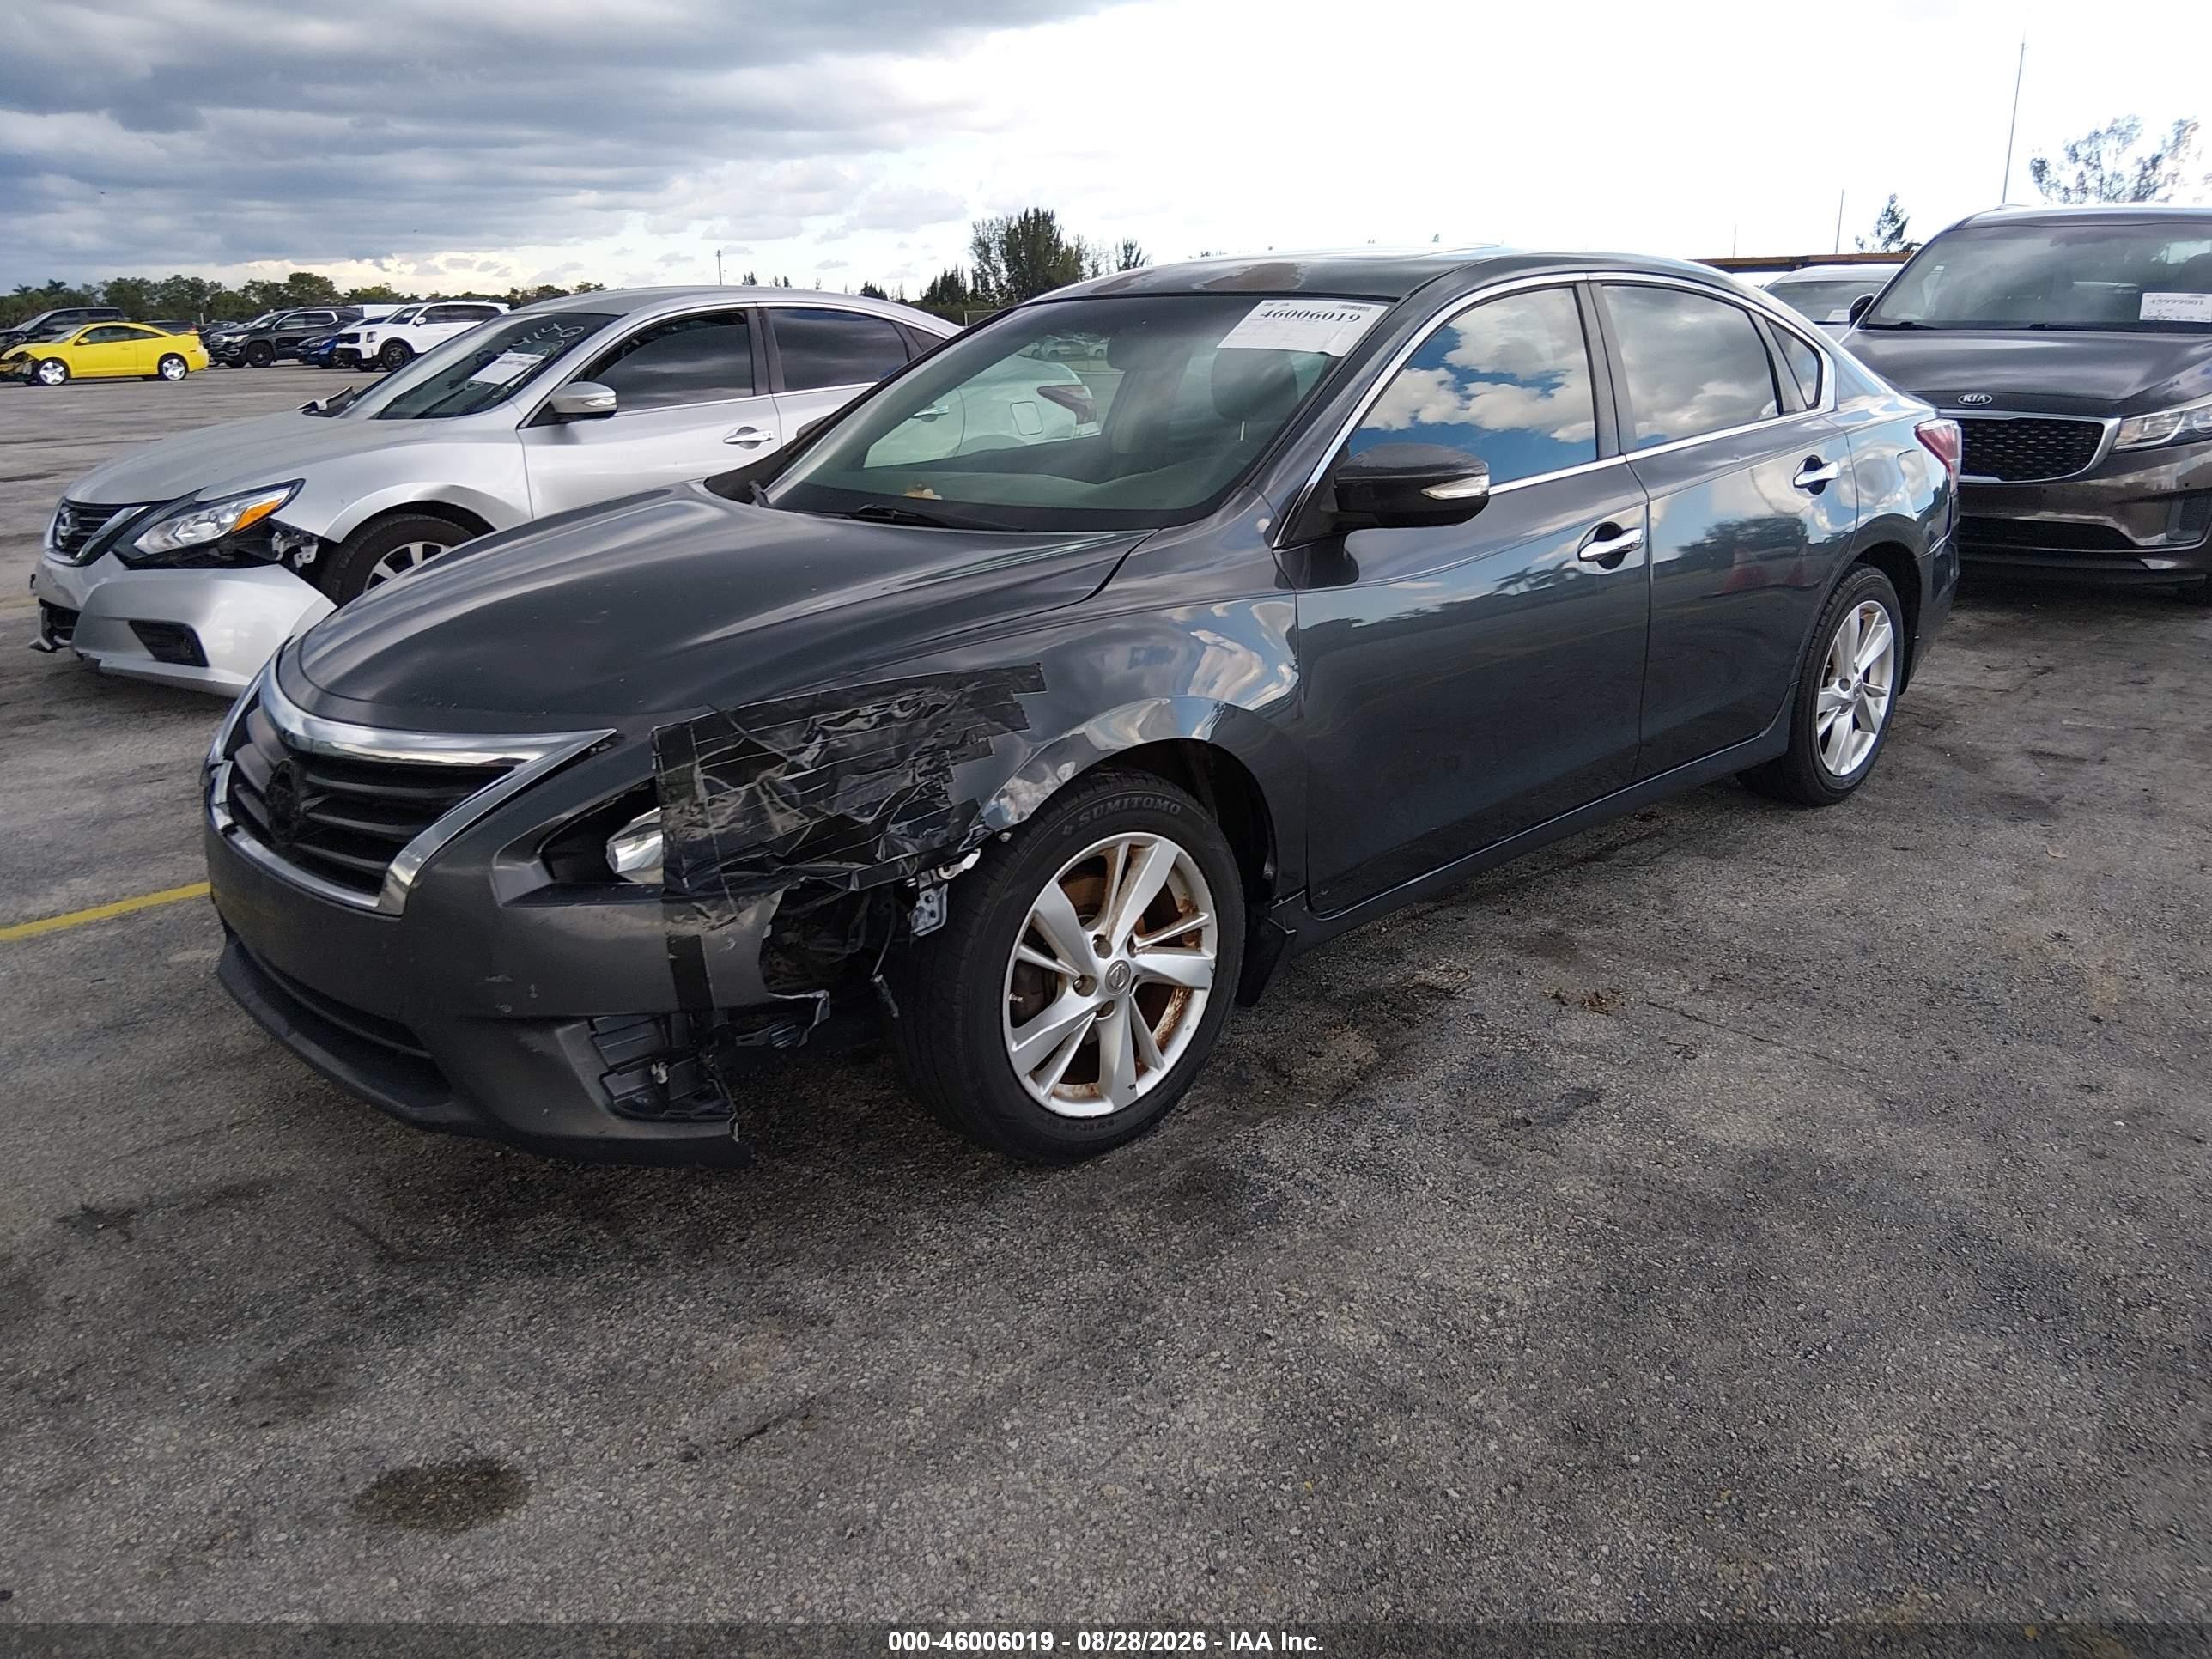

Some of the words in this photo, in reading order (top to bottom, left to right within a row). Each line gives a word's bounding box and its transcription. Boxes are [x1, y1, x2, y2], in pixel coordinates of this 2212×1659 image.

[1260, 309, 1360, 323] 46006019
[1962, 394, 1986, 403] KIA
[1079, 797, 1182, 825] SUMITOMO
